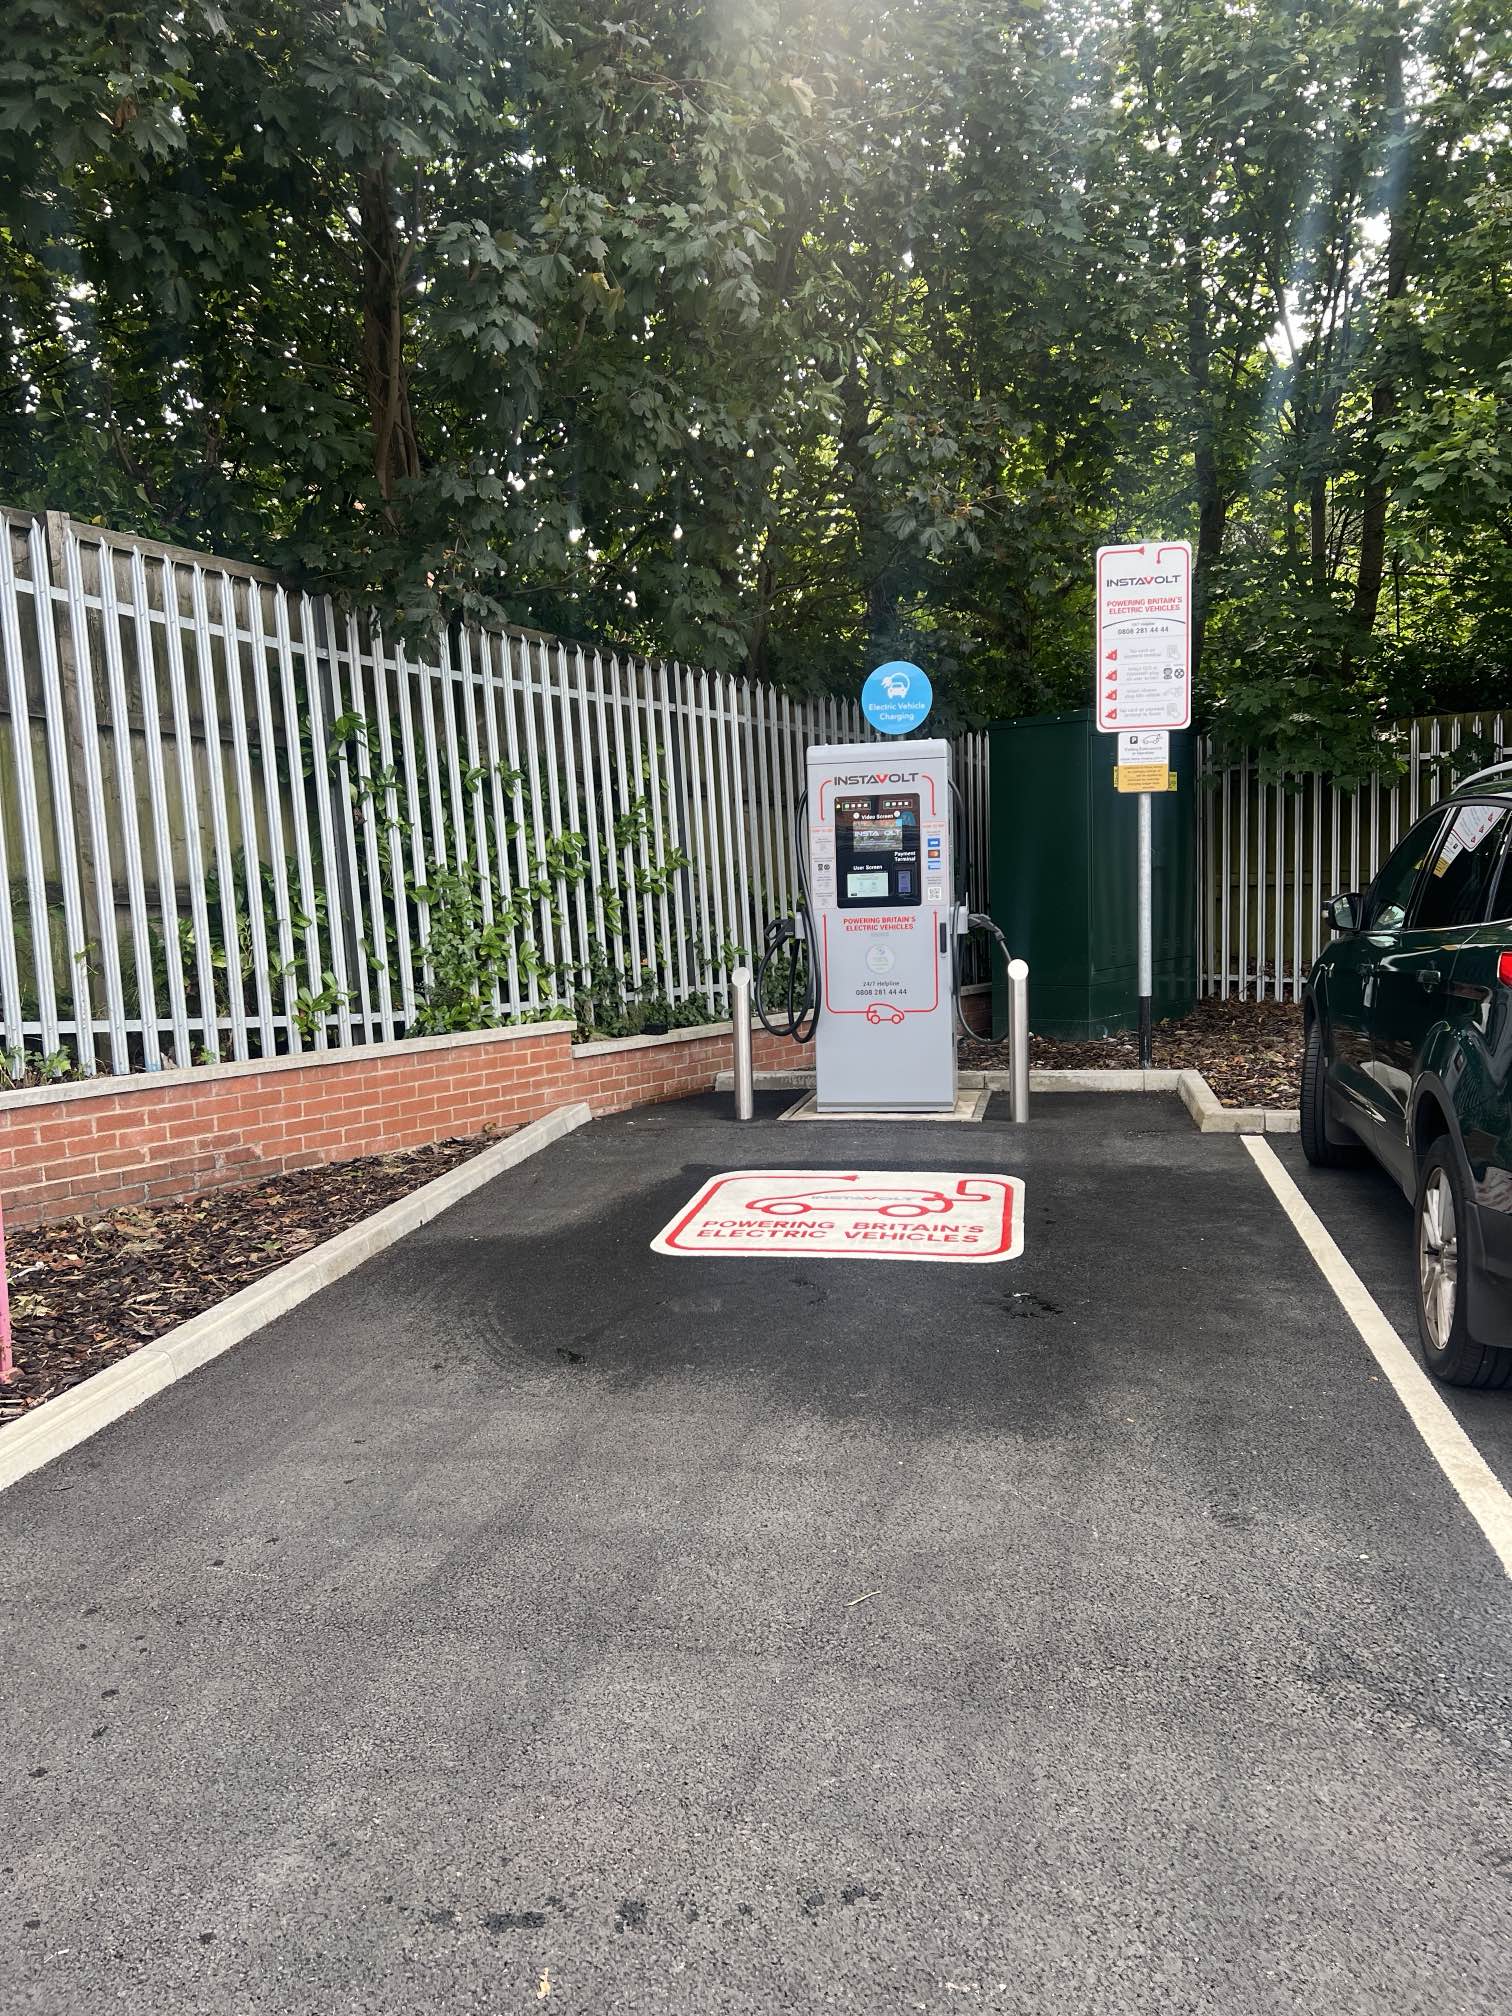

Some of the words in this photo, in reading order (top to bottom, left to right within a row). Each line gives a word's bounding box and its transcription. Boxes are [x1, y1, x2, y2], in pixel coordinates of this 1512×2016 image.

[1106, 574, 1182, 588] INSTAVOLT
[1106, 598, 1146, 607] POWERING
[1147, 596, 1183, 604] BRITAIN'S
[1109, 605, 1144, 615] ELECTRIC
[1145, 604, 1180, 613] VEHICLES
[868, 703, 896, 711] Electric
[898, 701, 925, 709] Vehicle
[879, 712, 914, 721] Charging
[834, 772, 919, 786] INSTAVOLT
[843, 917, 880, 925] POWERING
[882, 915, 916, 923] BRITAIN'S
[846, 924, 878, 932] ELECTRIC
[702, 1219, 835, 1229] POWERING
[852, 1221, 985, 1233] BRITAIN'S
[696, 1228, 828, 1238] ELECTRIC
[844, 1230, 979, 1243] VEHICLES
